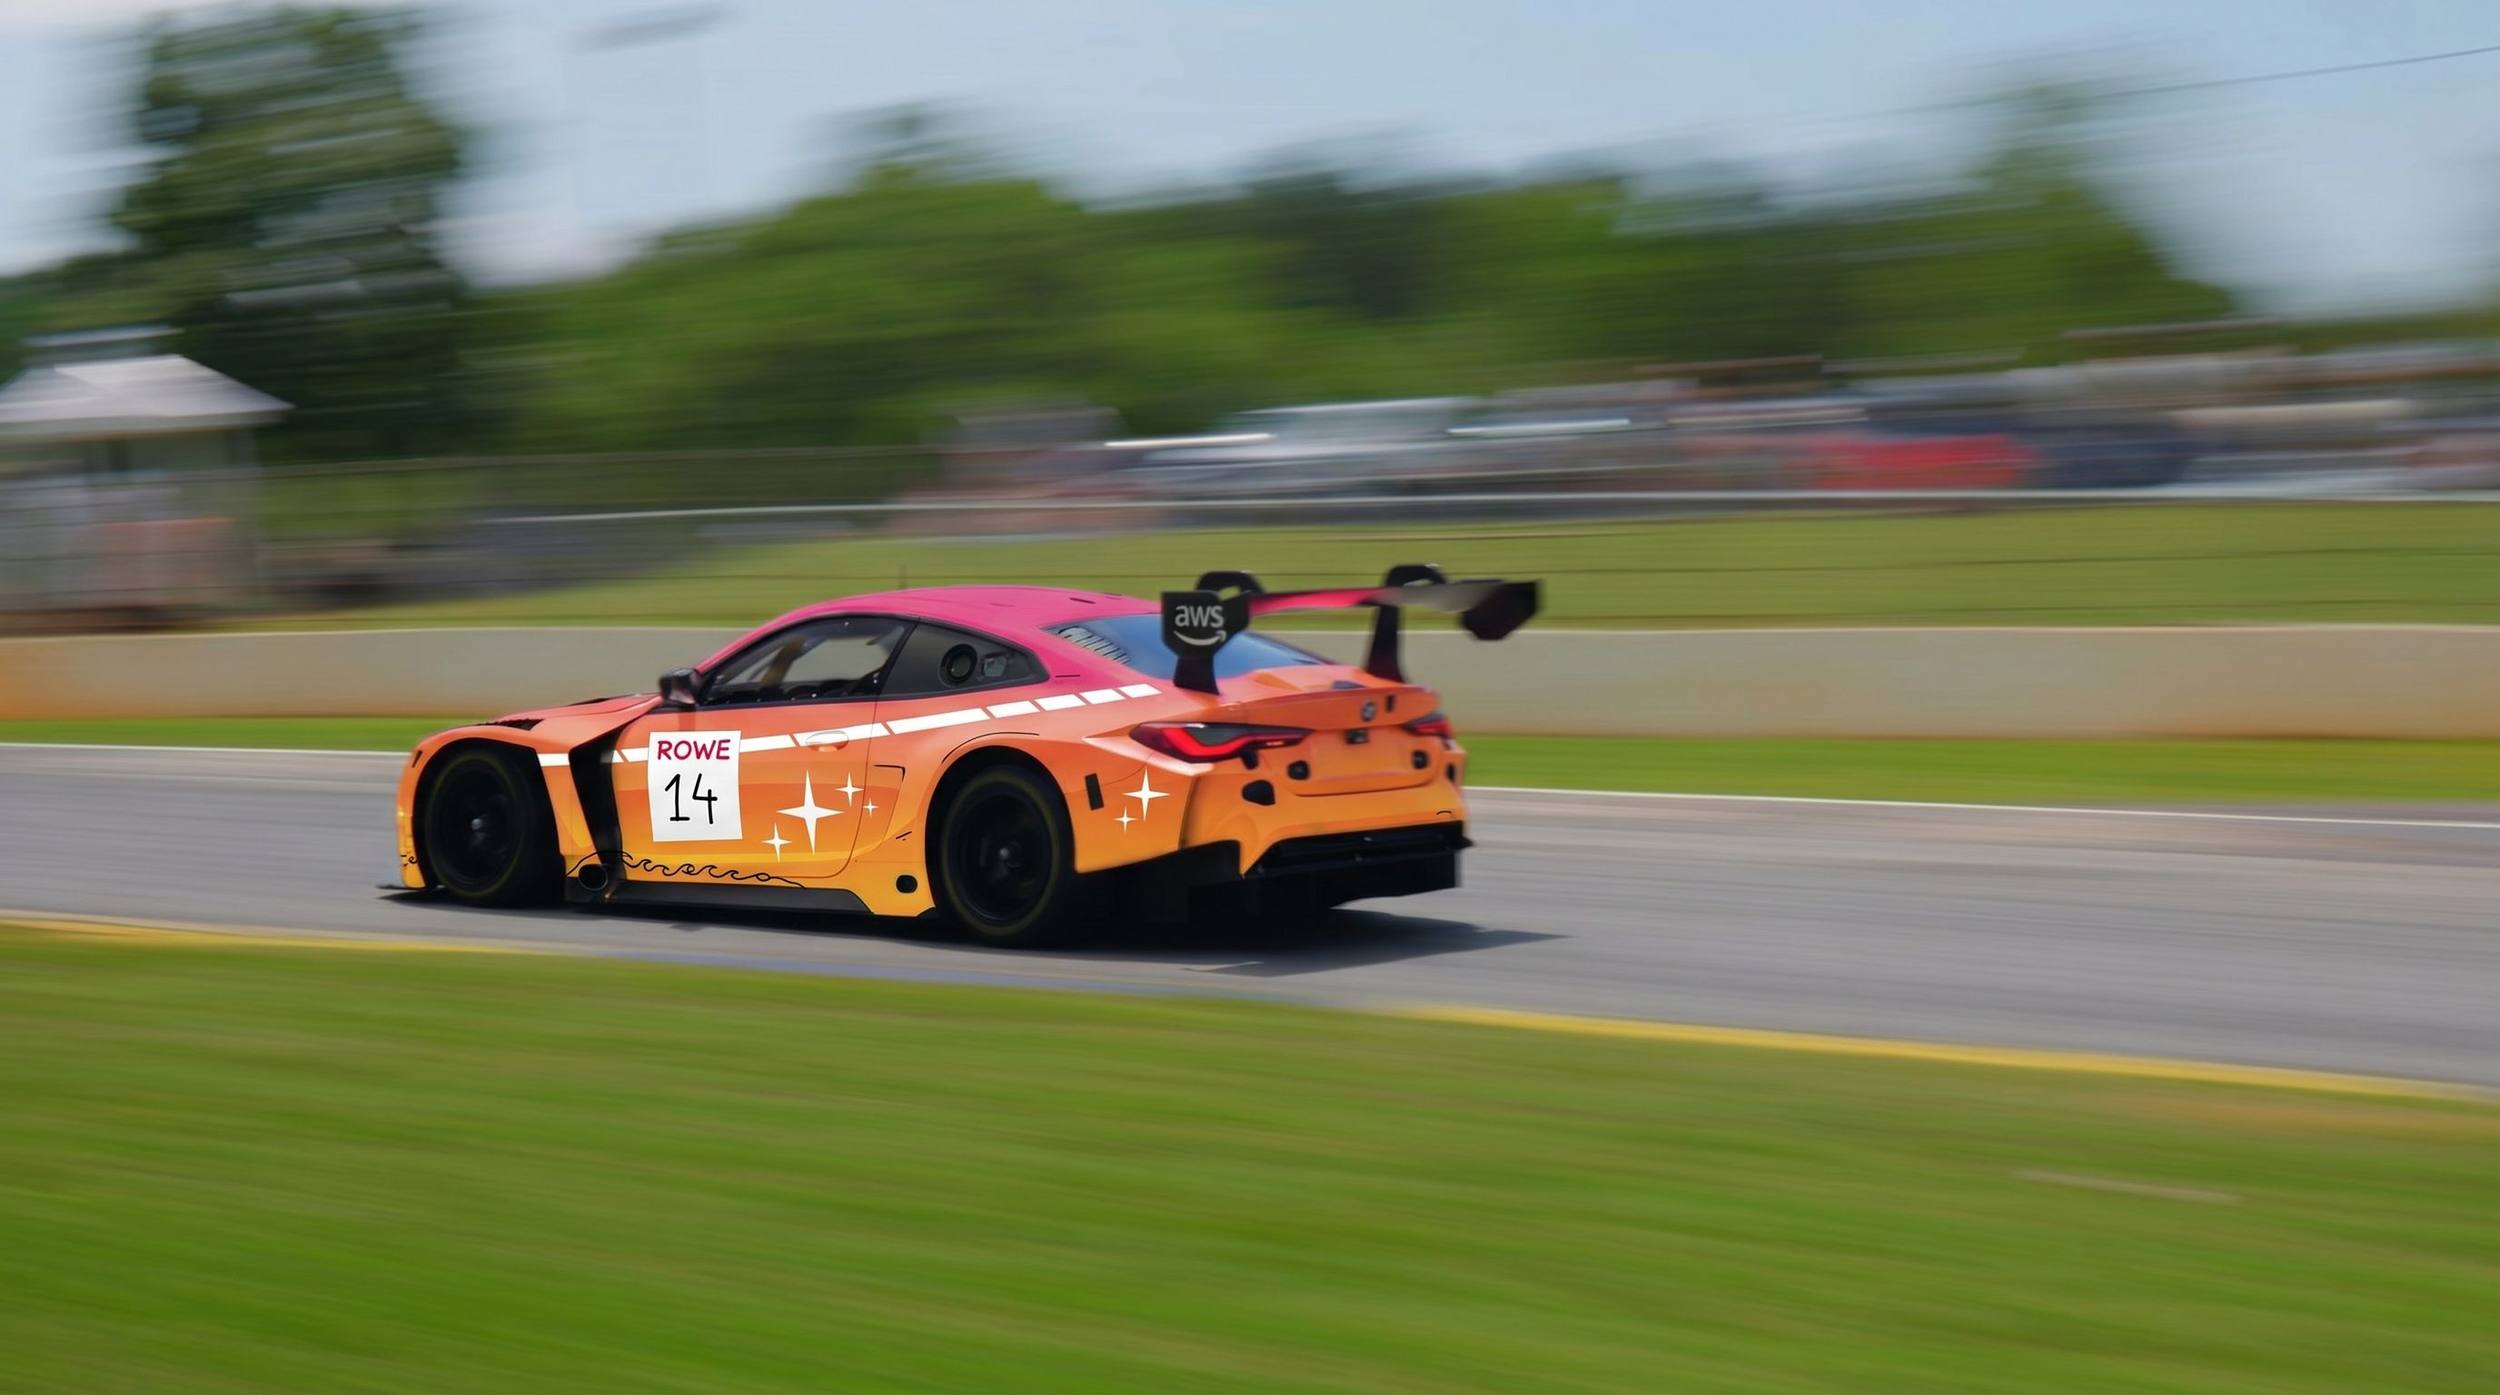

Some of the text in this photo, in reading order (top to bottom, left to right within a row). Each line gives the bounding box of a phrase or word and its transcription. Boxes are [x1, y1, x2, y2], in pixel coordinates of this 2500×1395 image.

[1174, 605, 1225, 628] aws
[657, 739, 731, 760] ROWE
[664, 773, 718, 824] 14
